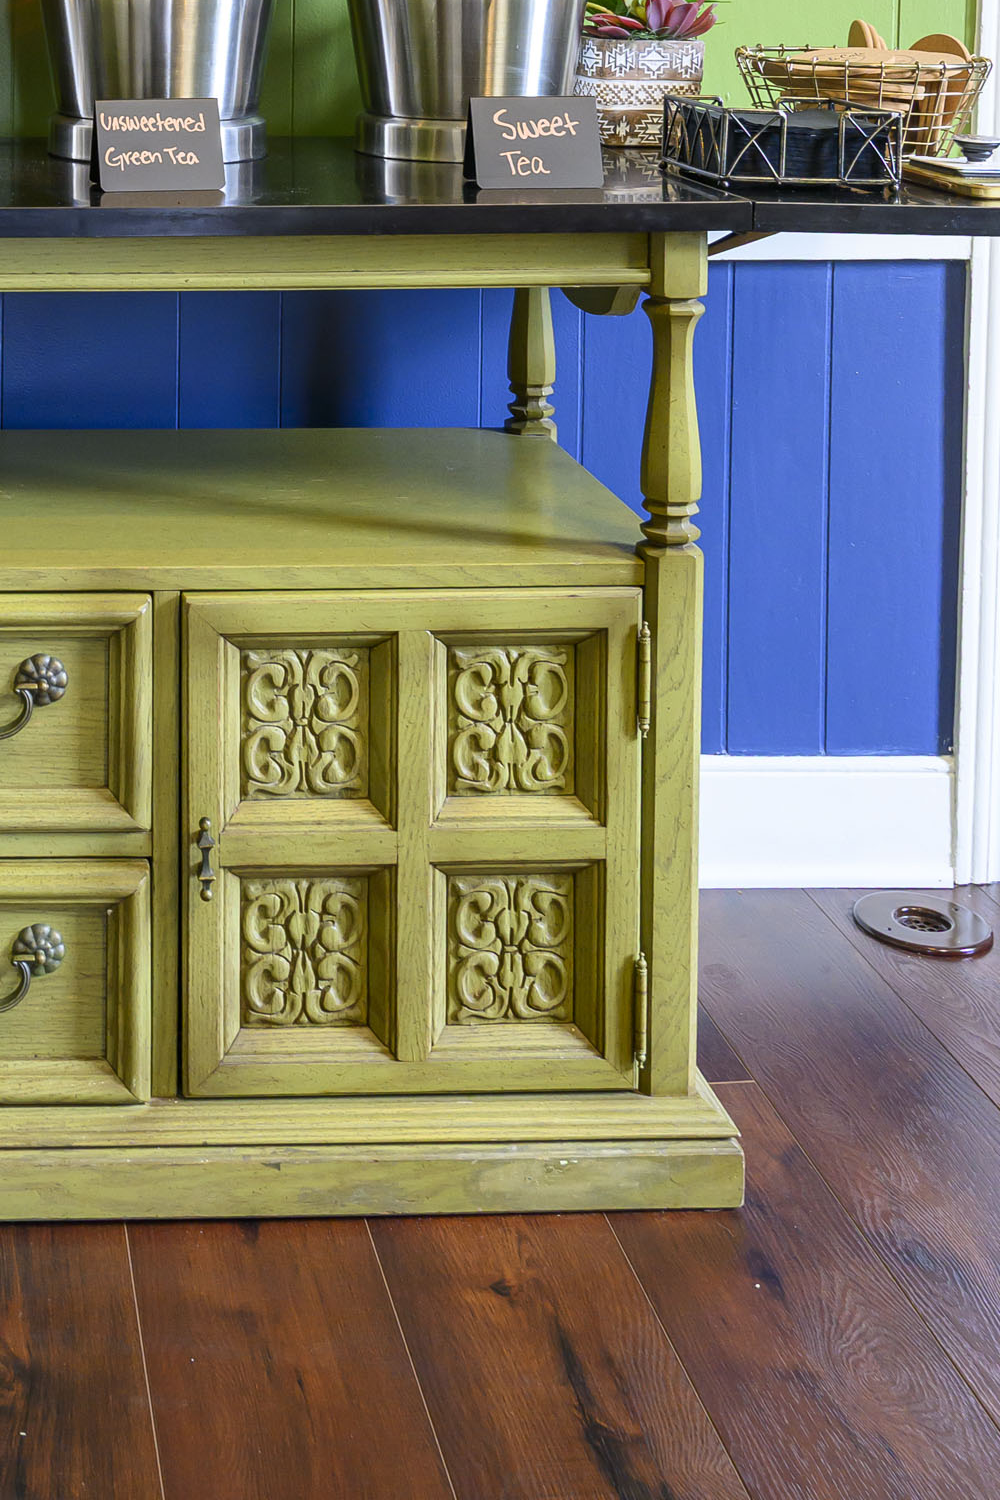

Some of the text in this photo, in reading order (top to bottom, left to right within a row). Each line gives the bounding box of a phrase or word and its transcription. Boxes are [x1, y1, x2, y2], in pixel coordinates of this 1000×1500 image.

[99, 112, 206, 132] Unsweetened
[492, 108, 580, 140] Sweet
[104, 143, 200, 172] Green Tea
[498, 150, 551, 176] Tea
